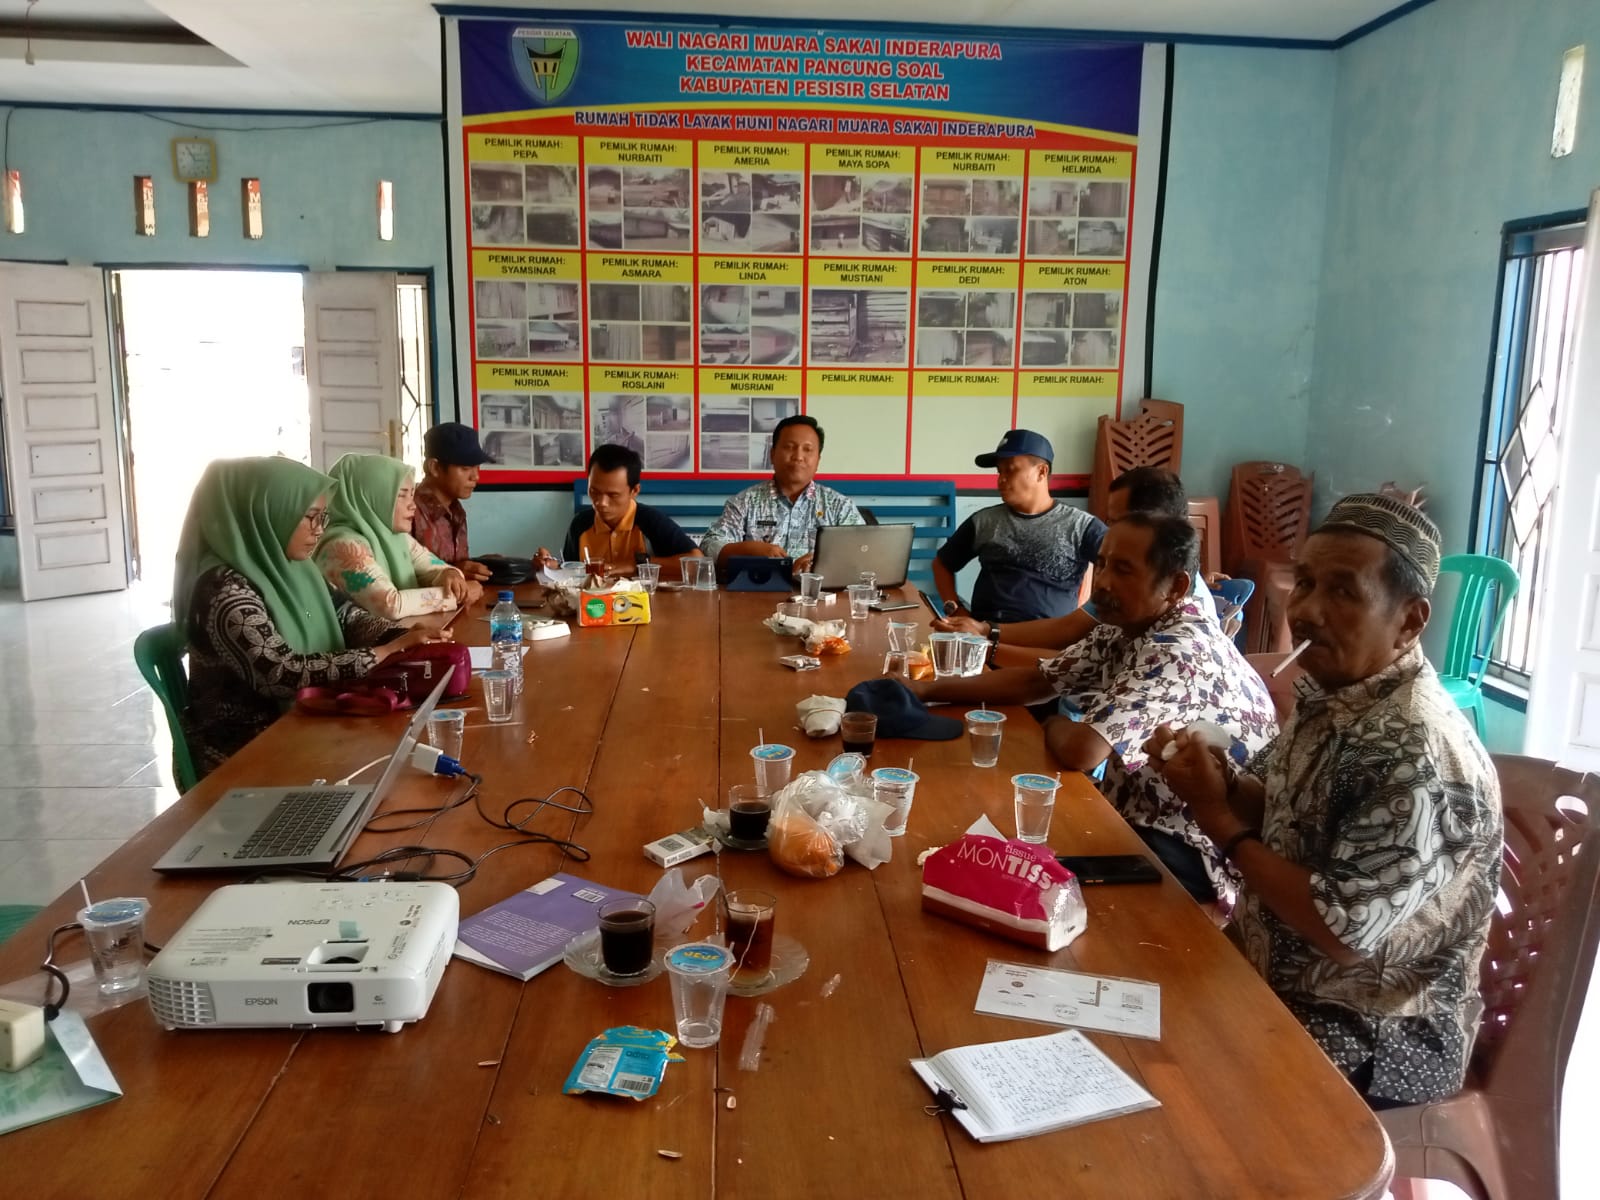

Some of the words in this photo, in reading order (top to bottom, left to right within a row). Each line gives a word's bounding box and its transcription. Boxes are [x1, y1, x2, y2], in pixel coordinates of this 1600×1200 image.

[625, 30, 673, 48] WALI
[677, 31, 749, 50] NAGARI
[754, 34, 820, 52] MUARA
[824, 37, 880, 55] SAKAI
[885, 39, 1002, 60] INDERAPURA
[686, 55, 799, 74] KECAMATAN
[804, 58, 892, 77] PANCUNG
[896, 61, 944, 79] SOAL
[679, 76, 789, 95] KABUPATEN
[794, 79, 865, 97] PESISIR
[869, 82, 950, 101] SELATAN
[574, 111, 630, 127] RUMAH
[633, 112, 680, 128] TIDAK
[683, 113, 732, 130] LAYAK
[735, 115, 773, 131] HUNI
[777, 116, 833, 133] NAGARI
[837, 118, 890, 134] MUARA
[893, 119, 939, 136] SAKAI
[942, 121, 1036, 138] INDERAPURA
[484, 138, 522, 148] PEMILIK
[525, 140, 563, 149] RUMAH:
[600, 142, 638, 151] PEMILIK
[640, 143, 677, 152] RUMAH:
[513, 150, 538, 159] PEPA
[714, 146, 751, 154] PEMILIK
[754, 146, 790, 156] RUMAH:
[826, 148, 863, 157] PEMILIK
[865, 149, 901, 158] RUMAH:
[618, 154, 663, 162] NURBAITI
[936, 152, 973, 160] PEMILIK
[974, 153, 1010, 161] RUMAH:
[1044, 154, 1081, 162] PEMILIK
[1082, 155, 1118, 164] RUMAH:
[734, 157, 770, 166] AMERIA
[838, 160, 863, 168] MAYA
[865, 160, 890, 169] SOPA
[952, 163, 996, 172] NURBAITI
[1062, 165, 1102, 174] HELMIDA
[488, 255, 526, 264] PEMILIK
[529, 256, 566, 265] RUMAH:
[602, 258, 639, 266] PEMILIK
[642, 259, 679, 268] RUMAH:
[501, 266, 556, 275] SYAMSINAR
[714, 261, 750, 270] PEMILIK
[752, 262, 789, 271] RUMAH:
[824, 264, 860, 272] PEMILIK
[862, 264, 897, 273] RUMAH:
[932, 266, 967, 274] PEMILIK
[970, 266, 1005, 275] RUMAH:
[622, 269, 662, 278] ASMARA
[1039, 267, 1074, 275] PEMILIK
[1076, 268, 1111, 276] RUMAH:
[739, 272, 766, 281] LINDA
[840, 274, 883, 283] MUSTIANI
[959, 276, 980, 284] DEDI
[492, 368, 530, 377] PEMILIK
[532, 369, 569, 378] RUMAH:
[604, 371, 641, 379] PEMILIK
[643, 371, 679, 380] RUMAH:
[714, 373, 750, 381] PEMILIK
[752, 374, 788, 382] RUMAH:
[514, 379, 550, 387] NURIDA
[822, 374, 857, 382] PEMILIK
[859, 375, 894, 383] RUMAH:
[965, 376, 1000, 384] RUMAH:
[1033, 376, 1068, 384] PEMILIK
[1070, 376, 1104, 384] RUMAH:
[622, 380, 665, 390] ROSLAINI
[730, 383, 774, 392] MUSRIANI
[1005, 844, 1037, 862] tissue
[957, 841, 1053, 890] MONTISS
[245, 998, 278, 1006] EPSON
